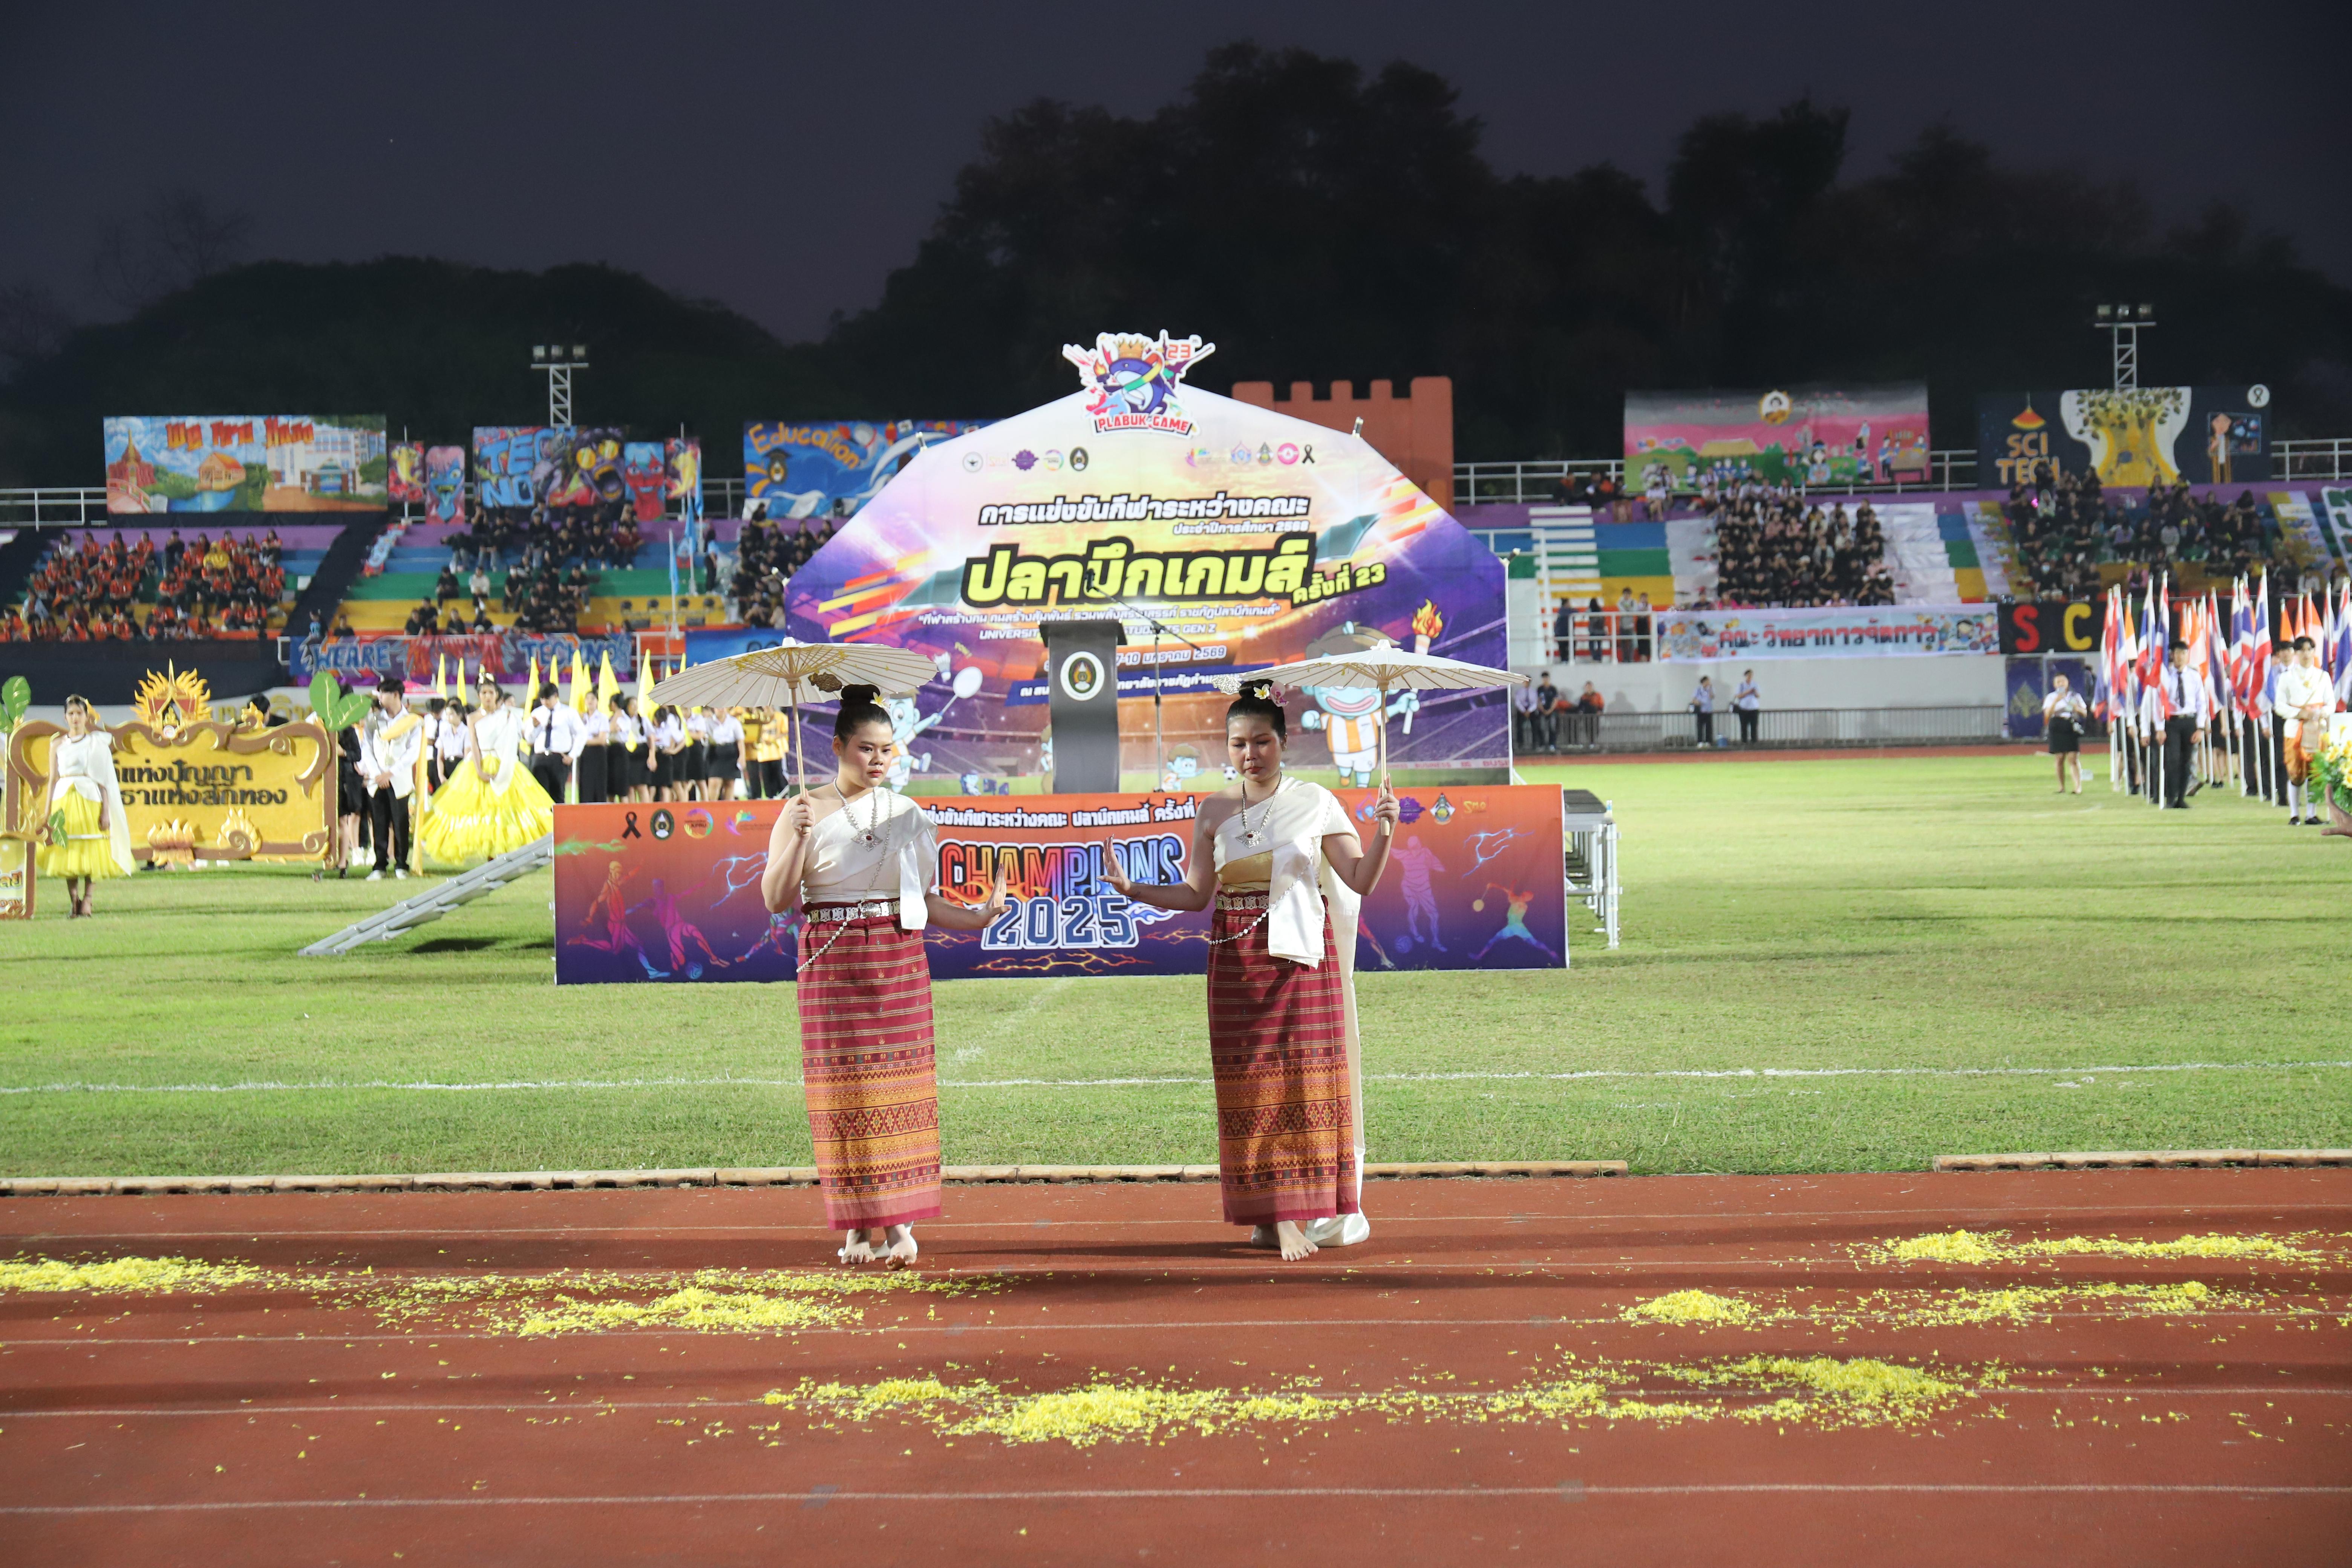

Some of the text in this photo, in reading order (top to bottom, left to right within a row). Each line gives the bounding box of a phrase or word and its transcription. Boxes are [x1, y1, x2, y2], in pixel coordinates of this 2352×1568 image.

[1098, 415, 1190, 432] PLABUK GAME
[748, 421, 860, 470] Education
[2006, 431, 2049, 459] SCI
[979, 492, 1309, 524] การแข่งขันกีฬาระหว่างคณะ
[964, 535, 1386, 605] ปลาบึกเกมส์ ครั้งที่ 23
[979, 628, 1042, 640] UNIVERSIT
[1182, 624, 1207, 634] GEN
[1208, 623, 1217, 633] Z
[1193, 646, 1227, 660] 2569
[923, 804, 1067, 827] ข่งขันกีฬาระหว่างคณะ
[939, 838, 1182, 899] CHAMPIONS
[981, 896, 1139, 950] 2025
